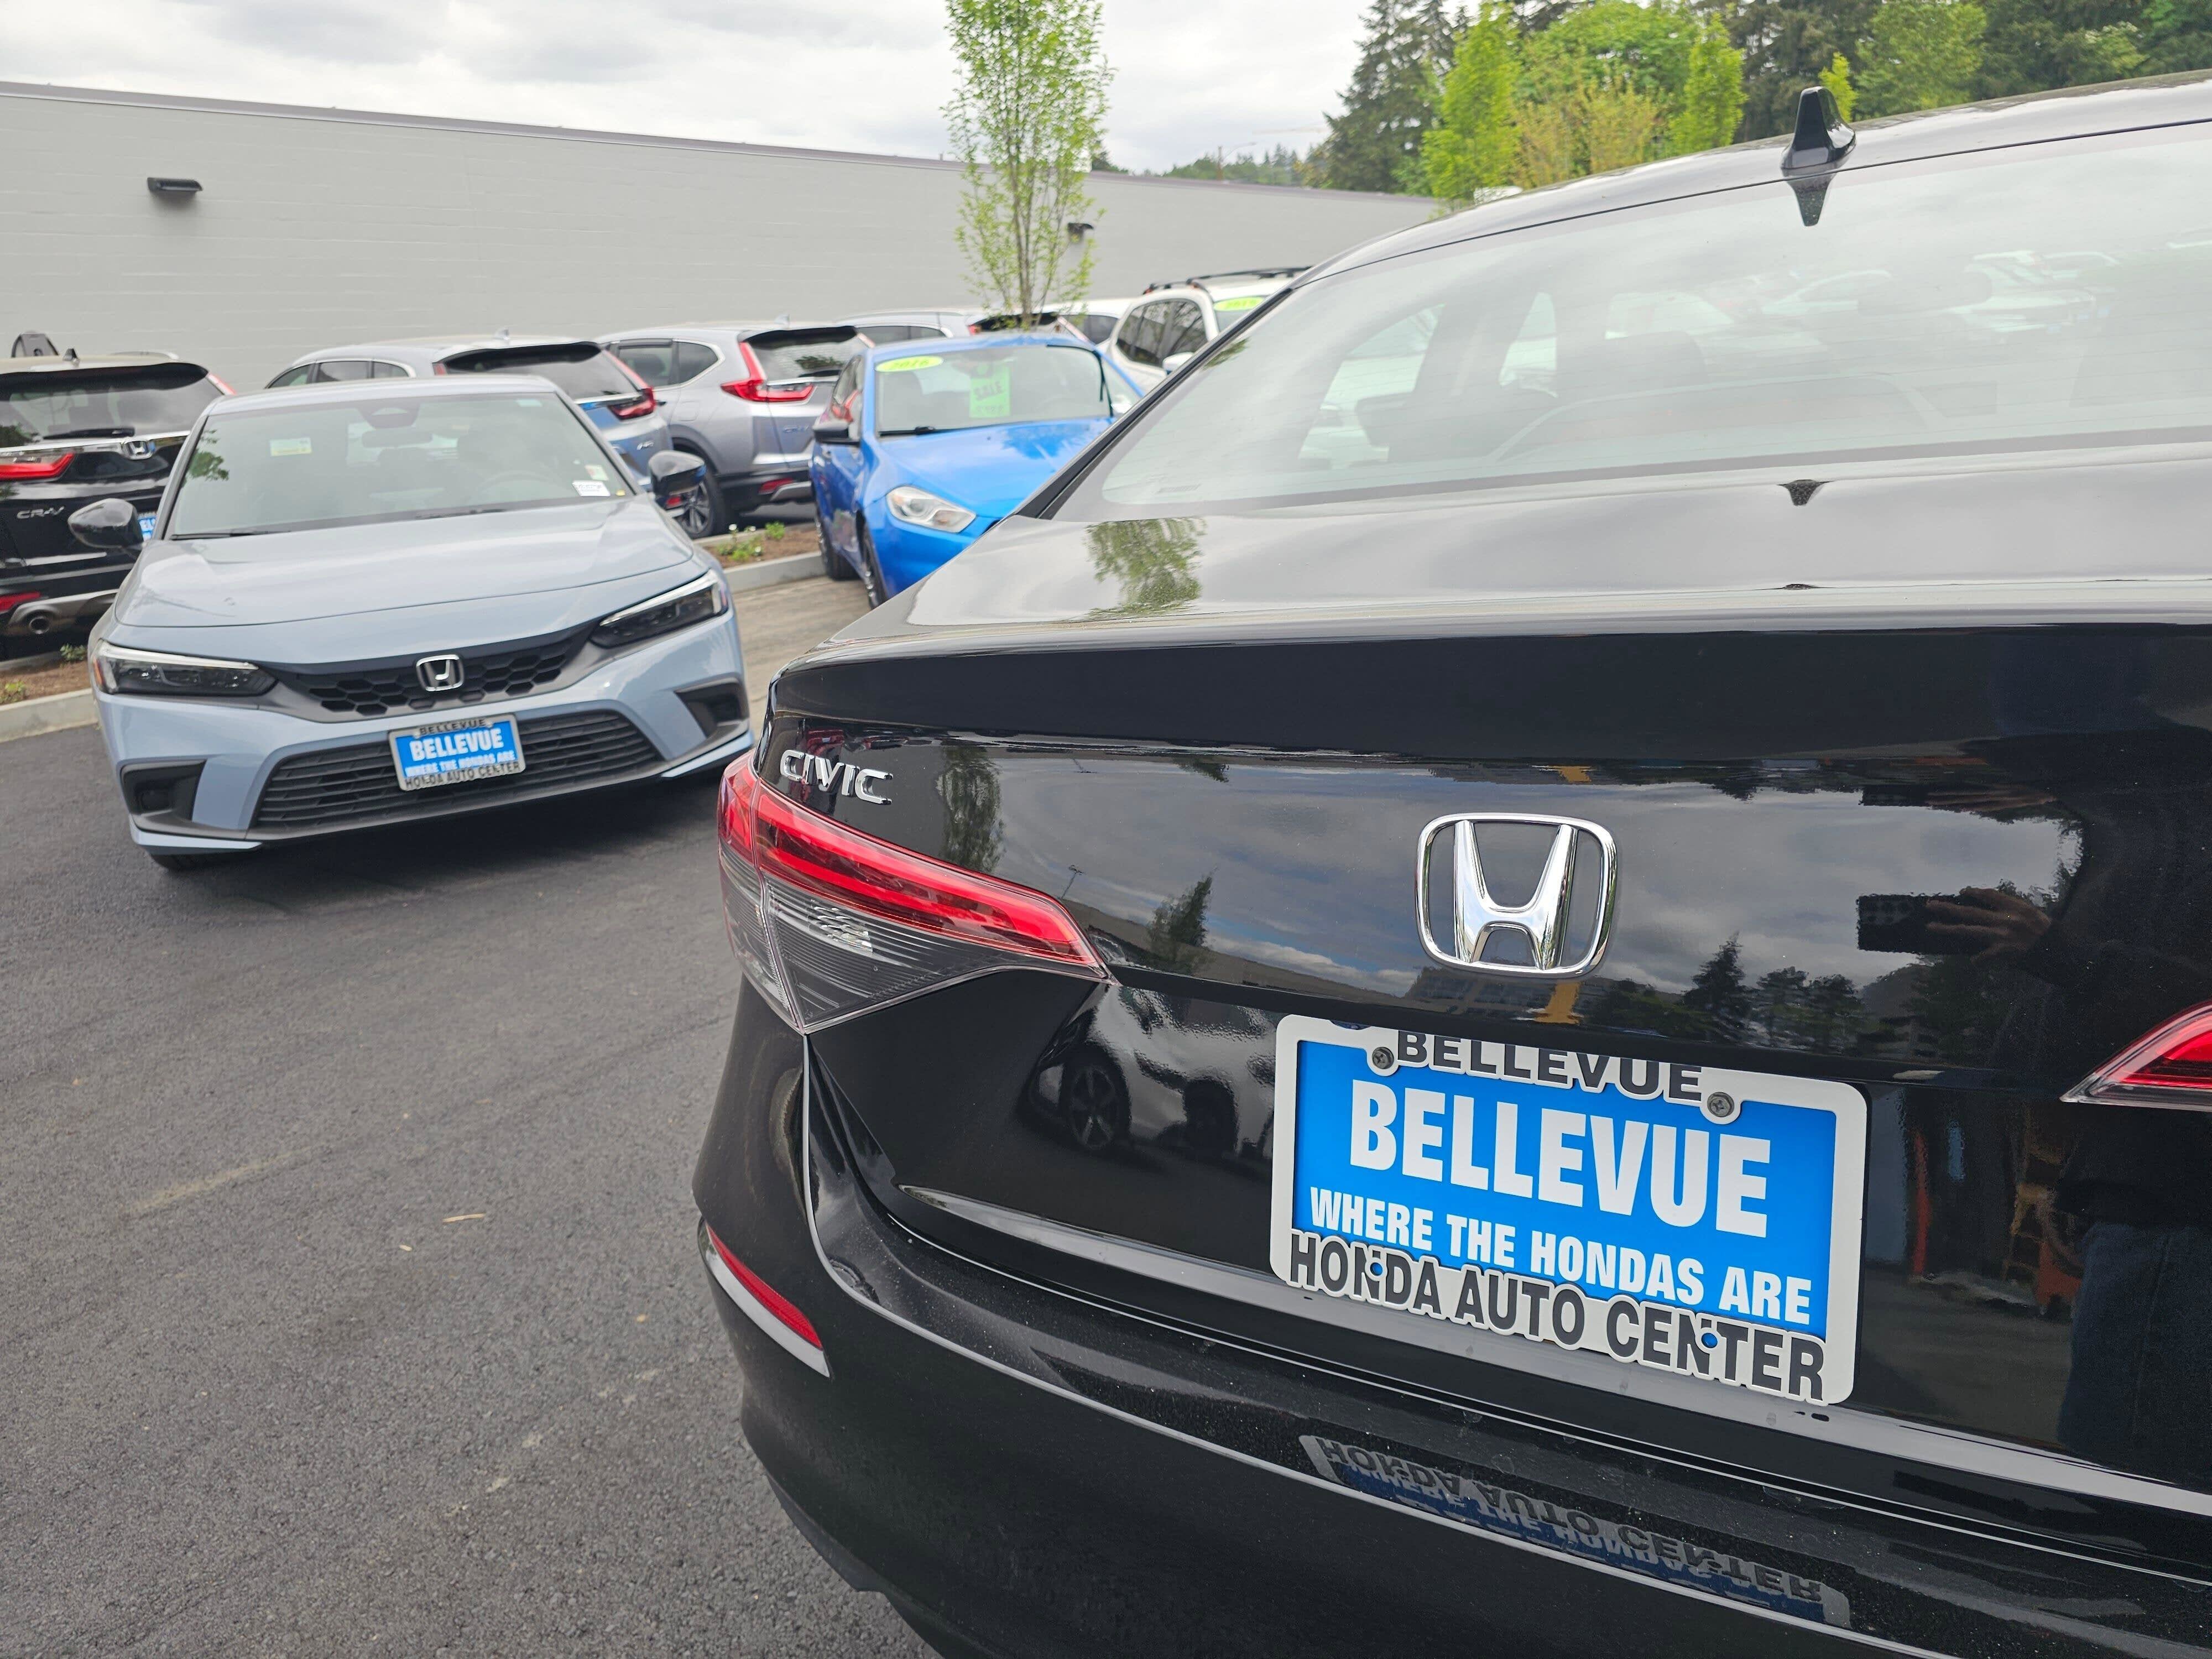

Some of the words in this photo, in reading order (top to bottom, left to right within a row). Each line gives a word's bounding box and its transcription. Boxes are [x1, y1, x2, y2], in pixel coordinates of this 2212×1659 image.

[409, 728, 504, 761] BELLEVUE
[419, 718, 486, 735] BELLEVUE
[405, 775, 443, 789] HONDA
[447, 768, 474, 781] AUTO
[479, 761, 520, 776] CENTER
[780, 749, 894, 805] CIVIC
[1397, 1030, 1702, 1102] BELLEVUE
[1350, 1079, 1771, 1238] BELLEVUE
[1310, 1186, 1433, 1251] WHERE
[1447, 1213, 1516, 1268] THE
[1530, 1230, 1705, 1305] HONDAS
[1718, 1266, 1812, 1326] ARE
[1290, 1233, 1442, 1316] HONDA
[1455, 1270, 1585, 1345] AUTO
[1606, 1301, 1825, 1402] CENTER
